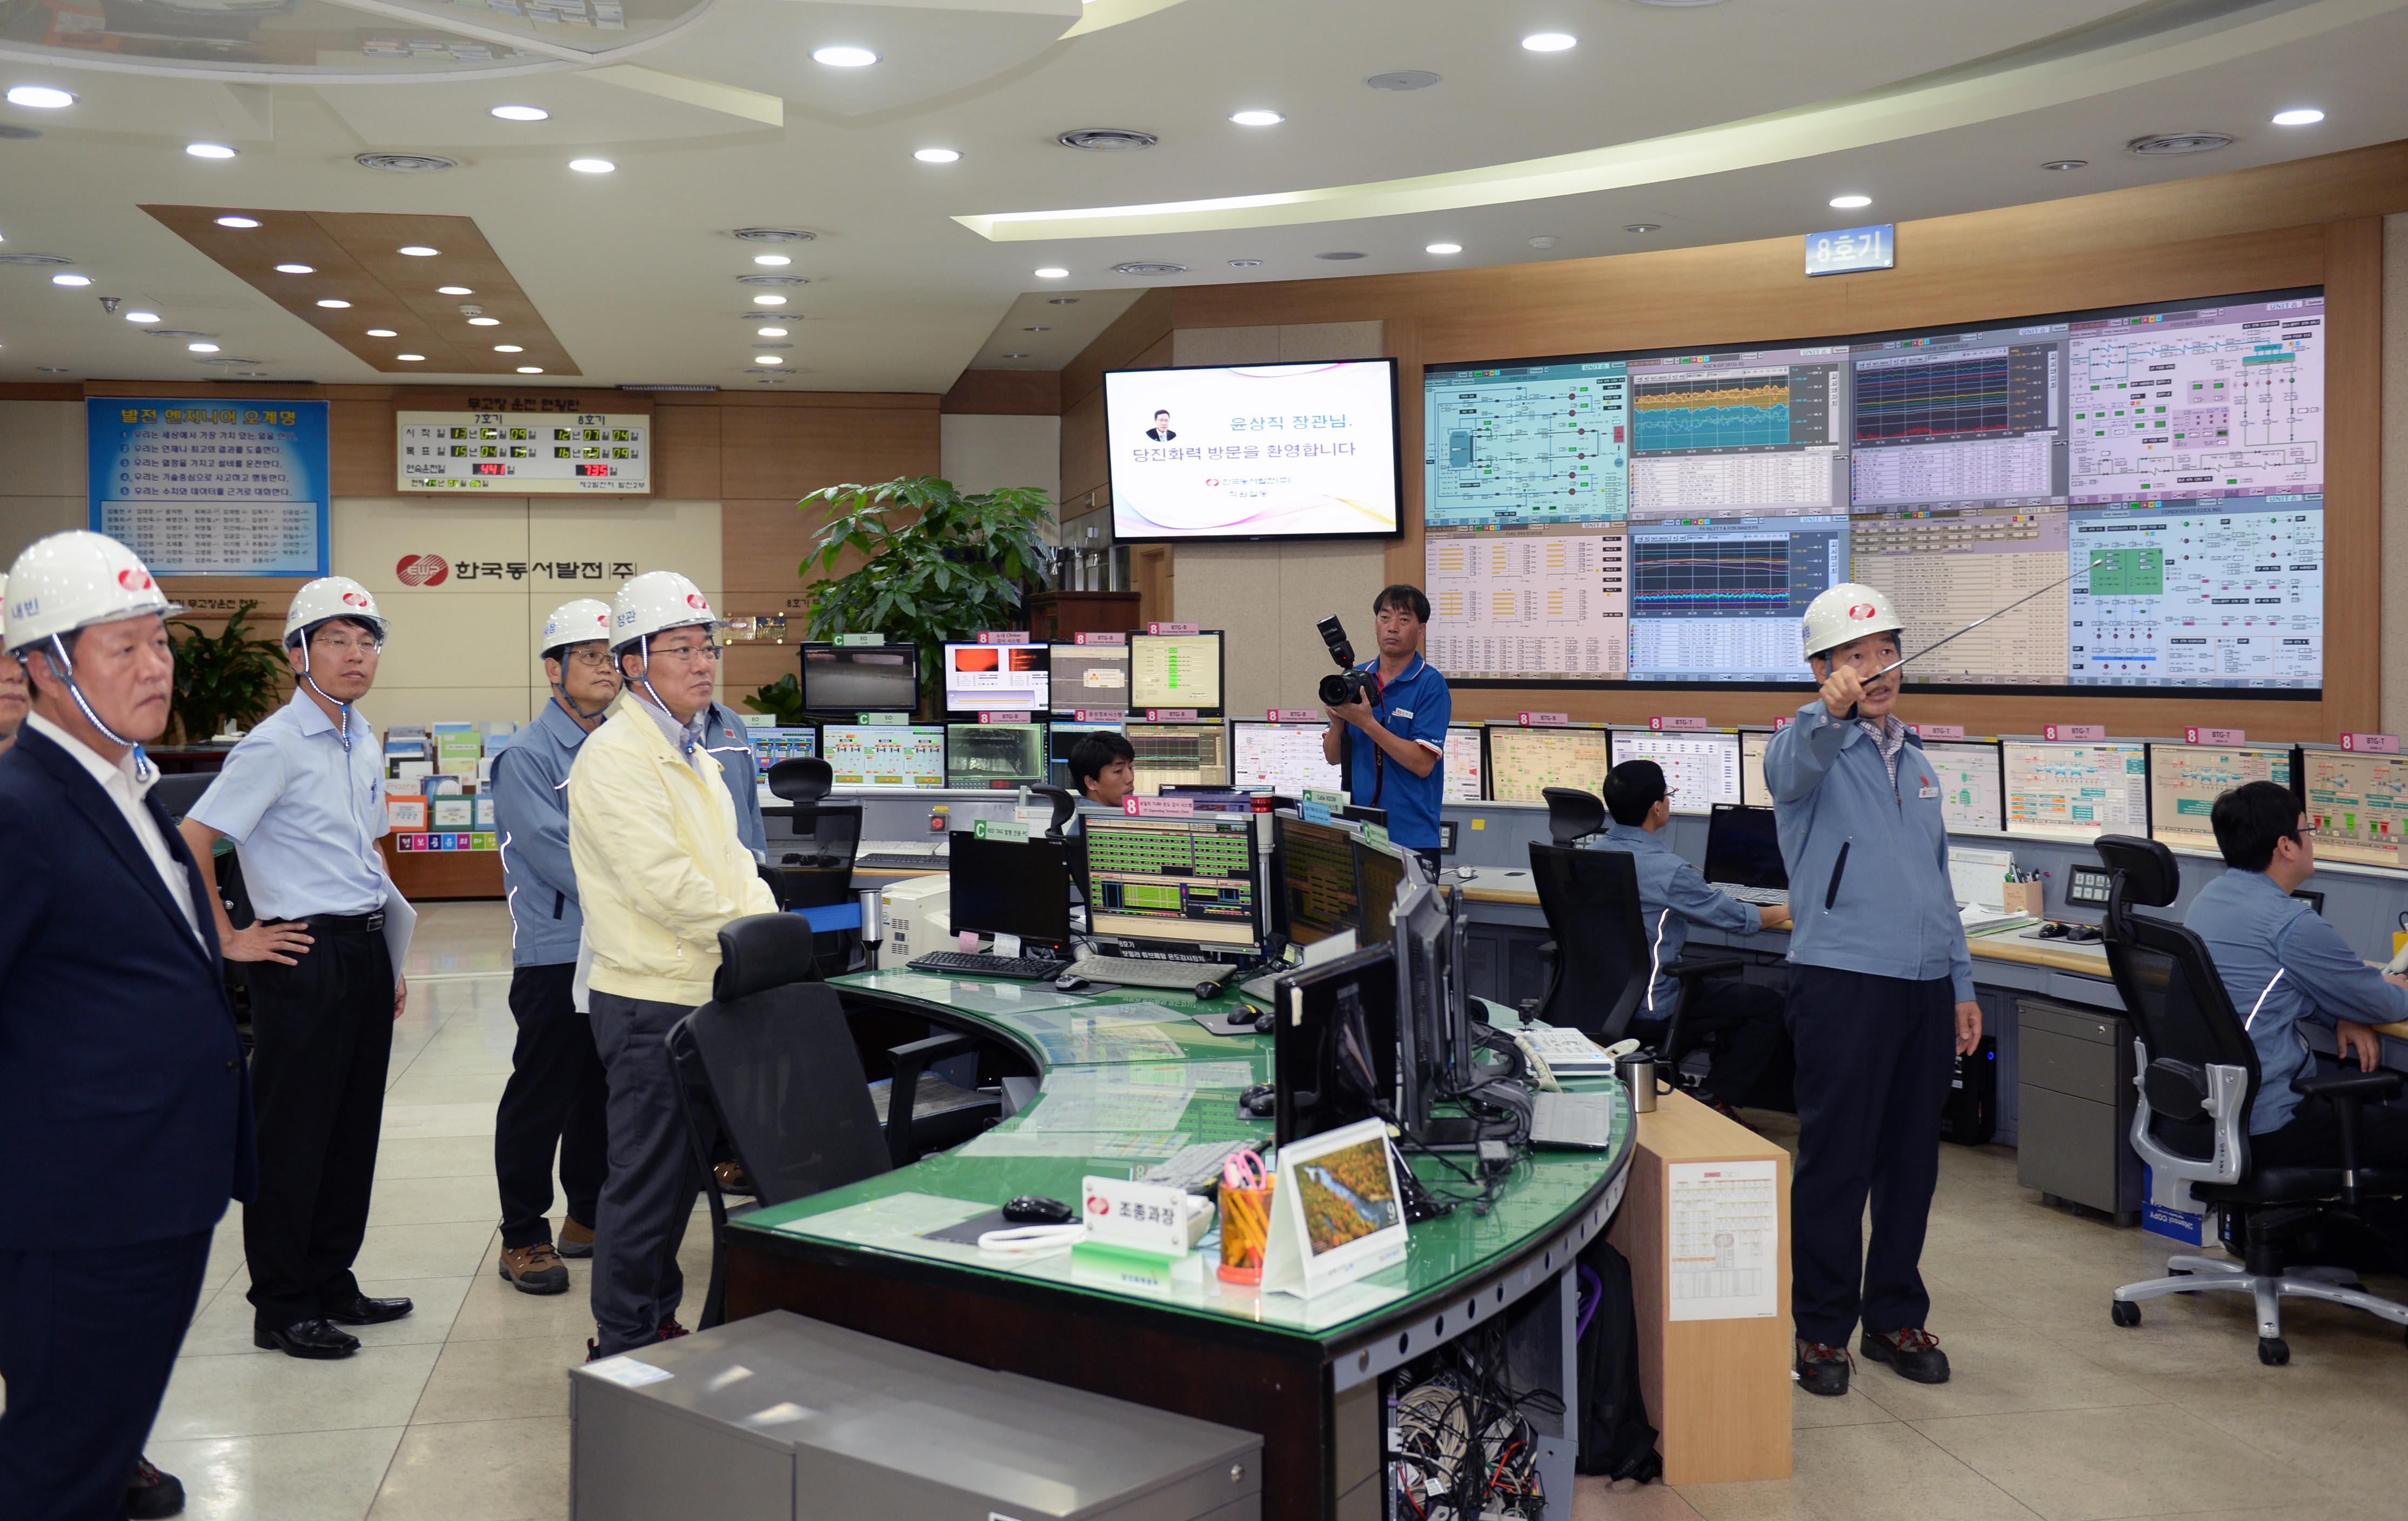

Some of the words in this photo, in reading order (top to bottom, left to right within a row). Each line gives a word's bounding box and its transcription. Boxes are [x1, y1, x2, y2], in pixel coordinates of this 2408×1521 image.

[1816, 231, 1881, 263] 8호기
[469, 398, 507, 411] 무고장
[511, 398, 536, 411] 운전
[121, 408, 158, 424] 발전
[164, 408, 237, 425] 엔지니어
[243, 409, 296, 426] 오계명
[475, 414, 503, 424] 7호기
[578, 415, 605, 425] 8호기
[1229, 416, 1285, 431] 윤상직
[1133, 446, 1202, 463] 당진화력
[1208, 445, 1260, 461] 방문을
[1267, 442, 1356, 458] 환영합니다
[135, 459, 159, 467] 우리는
[190, 459, 215, 468] 가지고
[480, 463, 506, 475] 441
[584, 464, 607, 477] 735
[135, 472, 159, 481] 우리는
[135, 487, 159, 495] 우리는
[407, 565, 441, 576] EWP
[455, 561, 603, 581] 한국동서발전
[11, 597, 39, 620] 내빈
[617, 610, 636, 627] 장관
[1151, 624, 1157, 634] 8
[834, 636, 842, 645] C
[980, 633, 987, 643] 8
[1078, 635, 1083, 644] 8
[860, 715, 868, 724] C
[981, 713, 987, 723] 8
[1078, 711, 1084, 721] 8
[1149, 711, 1155, 721] 8
[1270, 711, 1276, 721] 8
[1520, 714, 1528, 724] 8
[1652, 718, 1660, 729] 8
[2047, 728, 2055, 739] 8
[2188, 730, 2196, 742] 8
[2343, 735, 2351, 748] 8
[1127, 799, 1137, 814] 8
[1297, 803, 1303, 818] 7
[976, 823, 985, 837] C
[1364, 826, 1371, 843] C
[1119, 940, 1135, 948] 8호기
[1122, 950, 1141, 958] 보일러
[1119, 1201, 1174, 1226] 조종과장
[1386, 1201, 1397, 1220] 9
[2150, 1211, 2168, 1222] COPY
[2169, 1216, 2192, 1229] Hansol
